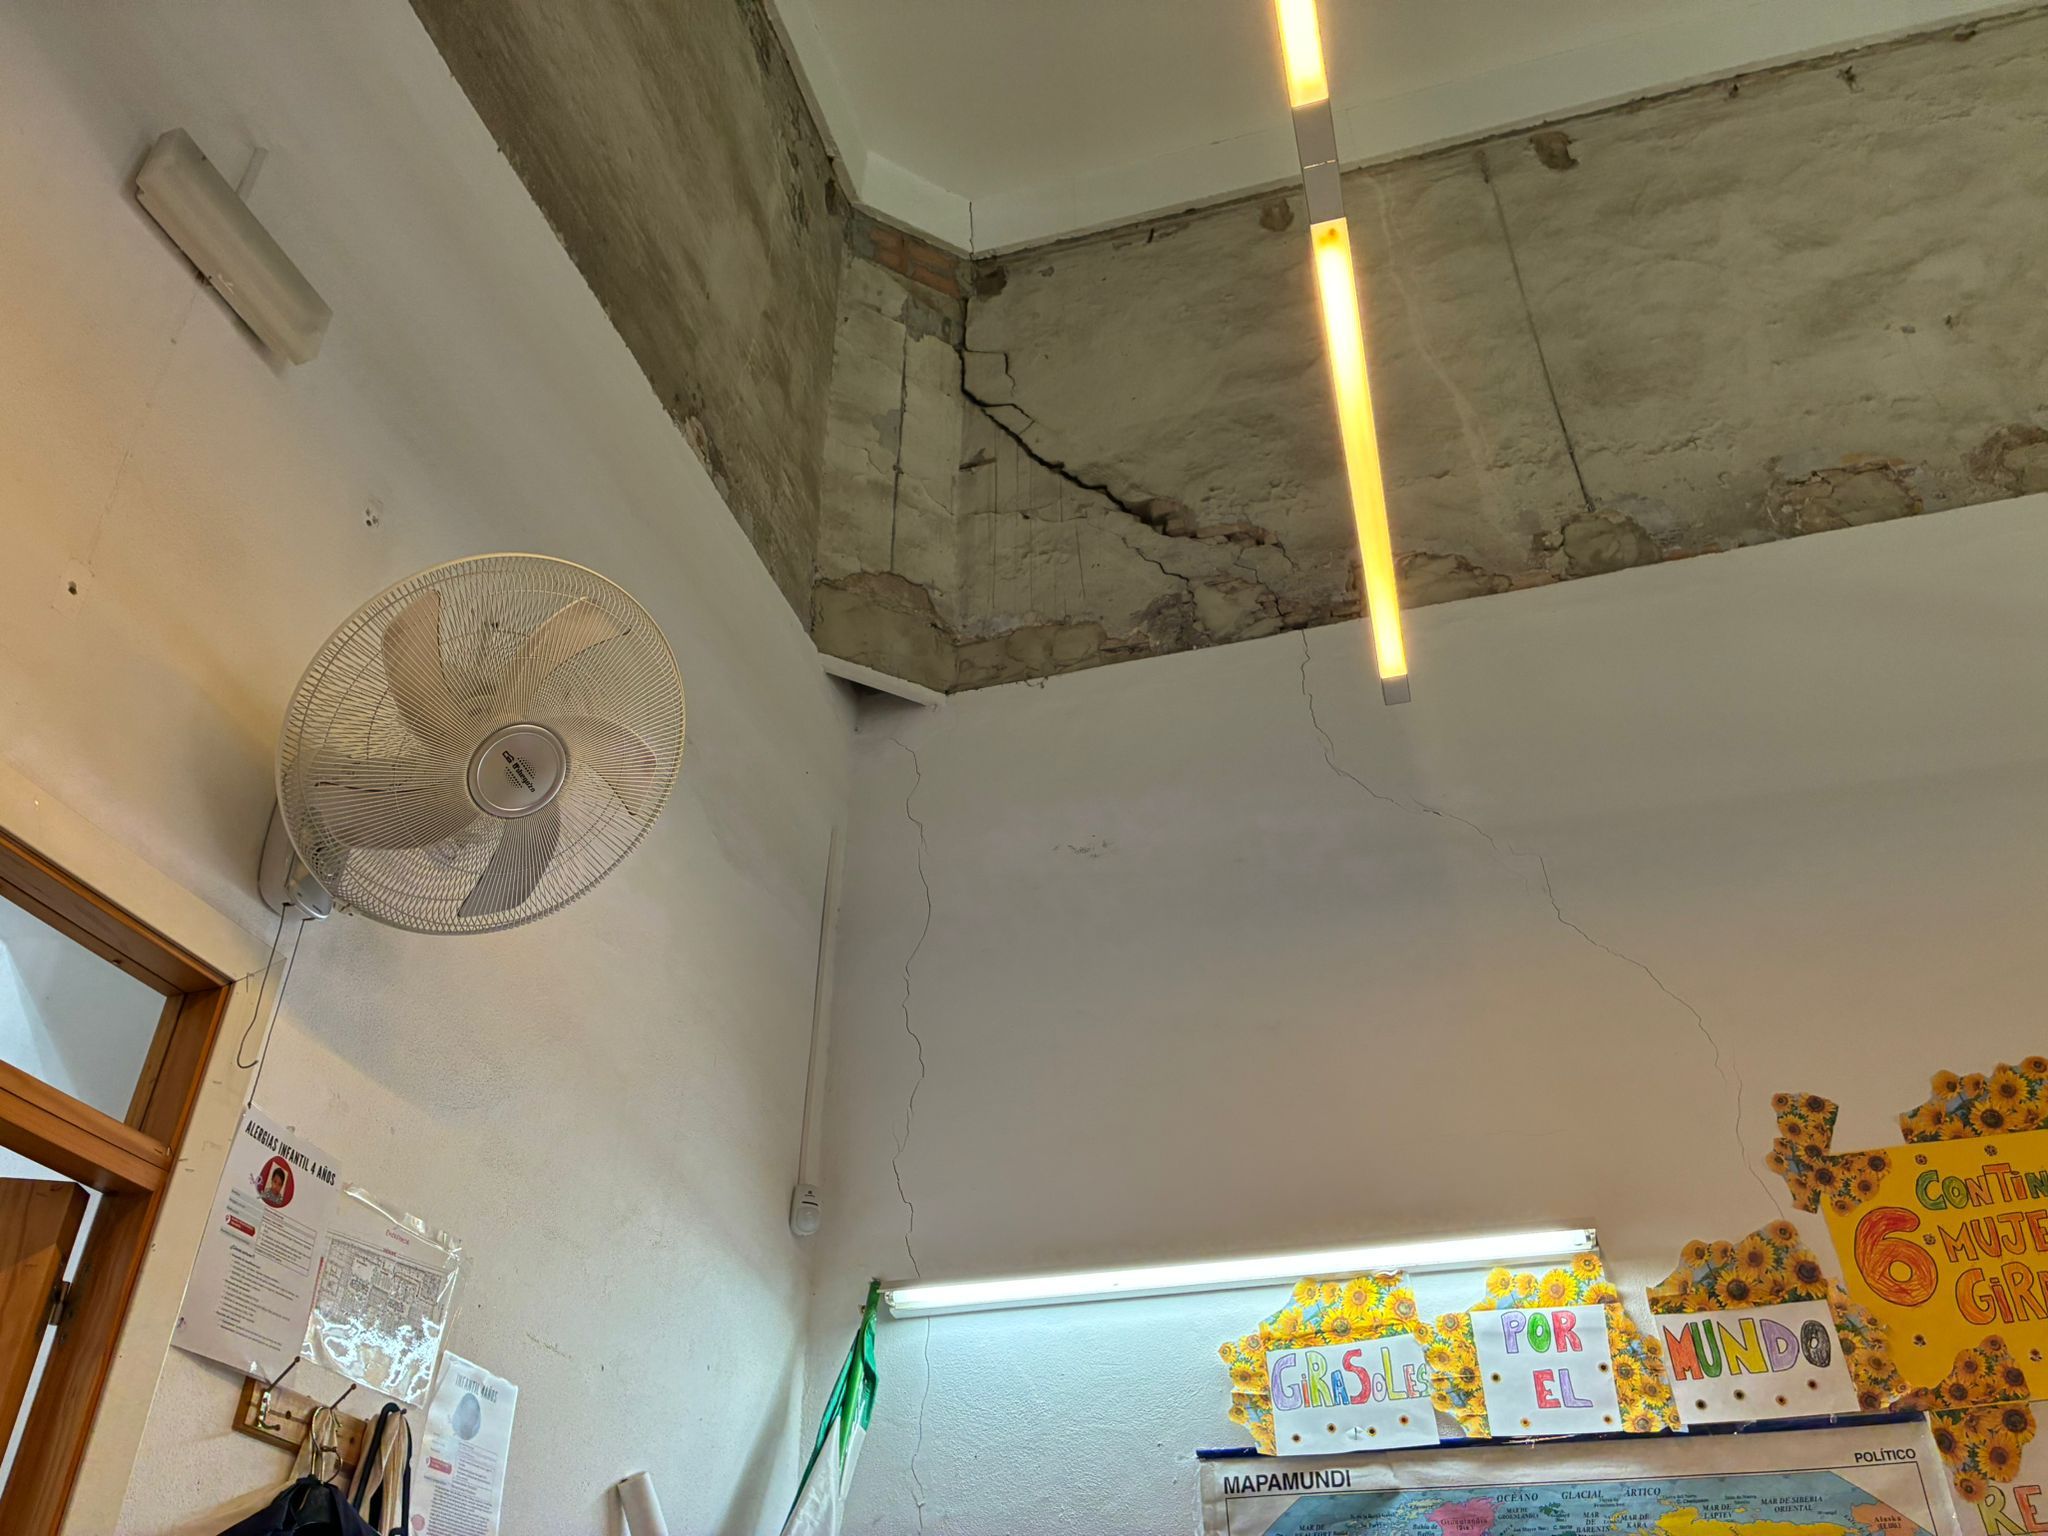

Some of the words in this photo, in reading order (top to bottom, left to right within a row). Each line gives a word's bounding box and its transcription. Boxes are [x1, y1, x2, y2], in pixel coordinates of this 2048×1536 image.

[245, 1120, 279, 1152] ALERGIAS
[278, 1142, 311, 1172] INFANTIL
[310, 1162, 317, 1176] 4
[317, 1165, 337, 1186] AÑOS
[1854, 1206, 1939, 1306] 6
[1501, 1311, 1583, 1354] POR
[1664, 1318, 1831, 1381] MUNDO
[1533, 1368, 1594, 1408] EL
[1854, 1447, 1916, 1463] POLÍTICO
[1224, 1469, 1352, 1494] MAPAMUNDI
[1496, 1488, 1539, 1503] OCÉANO
[1561, 1489, 1604, 1500] GLACIAL
[1624, 1486, 1661, 1498] ÁRTICO
[1585, 1518, 1596, 1526] DE
[1774, 1504, 1813, 1513] ORIENTAL
